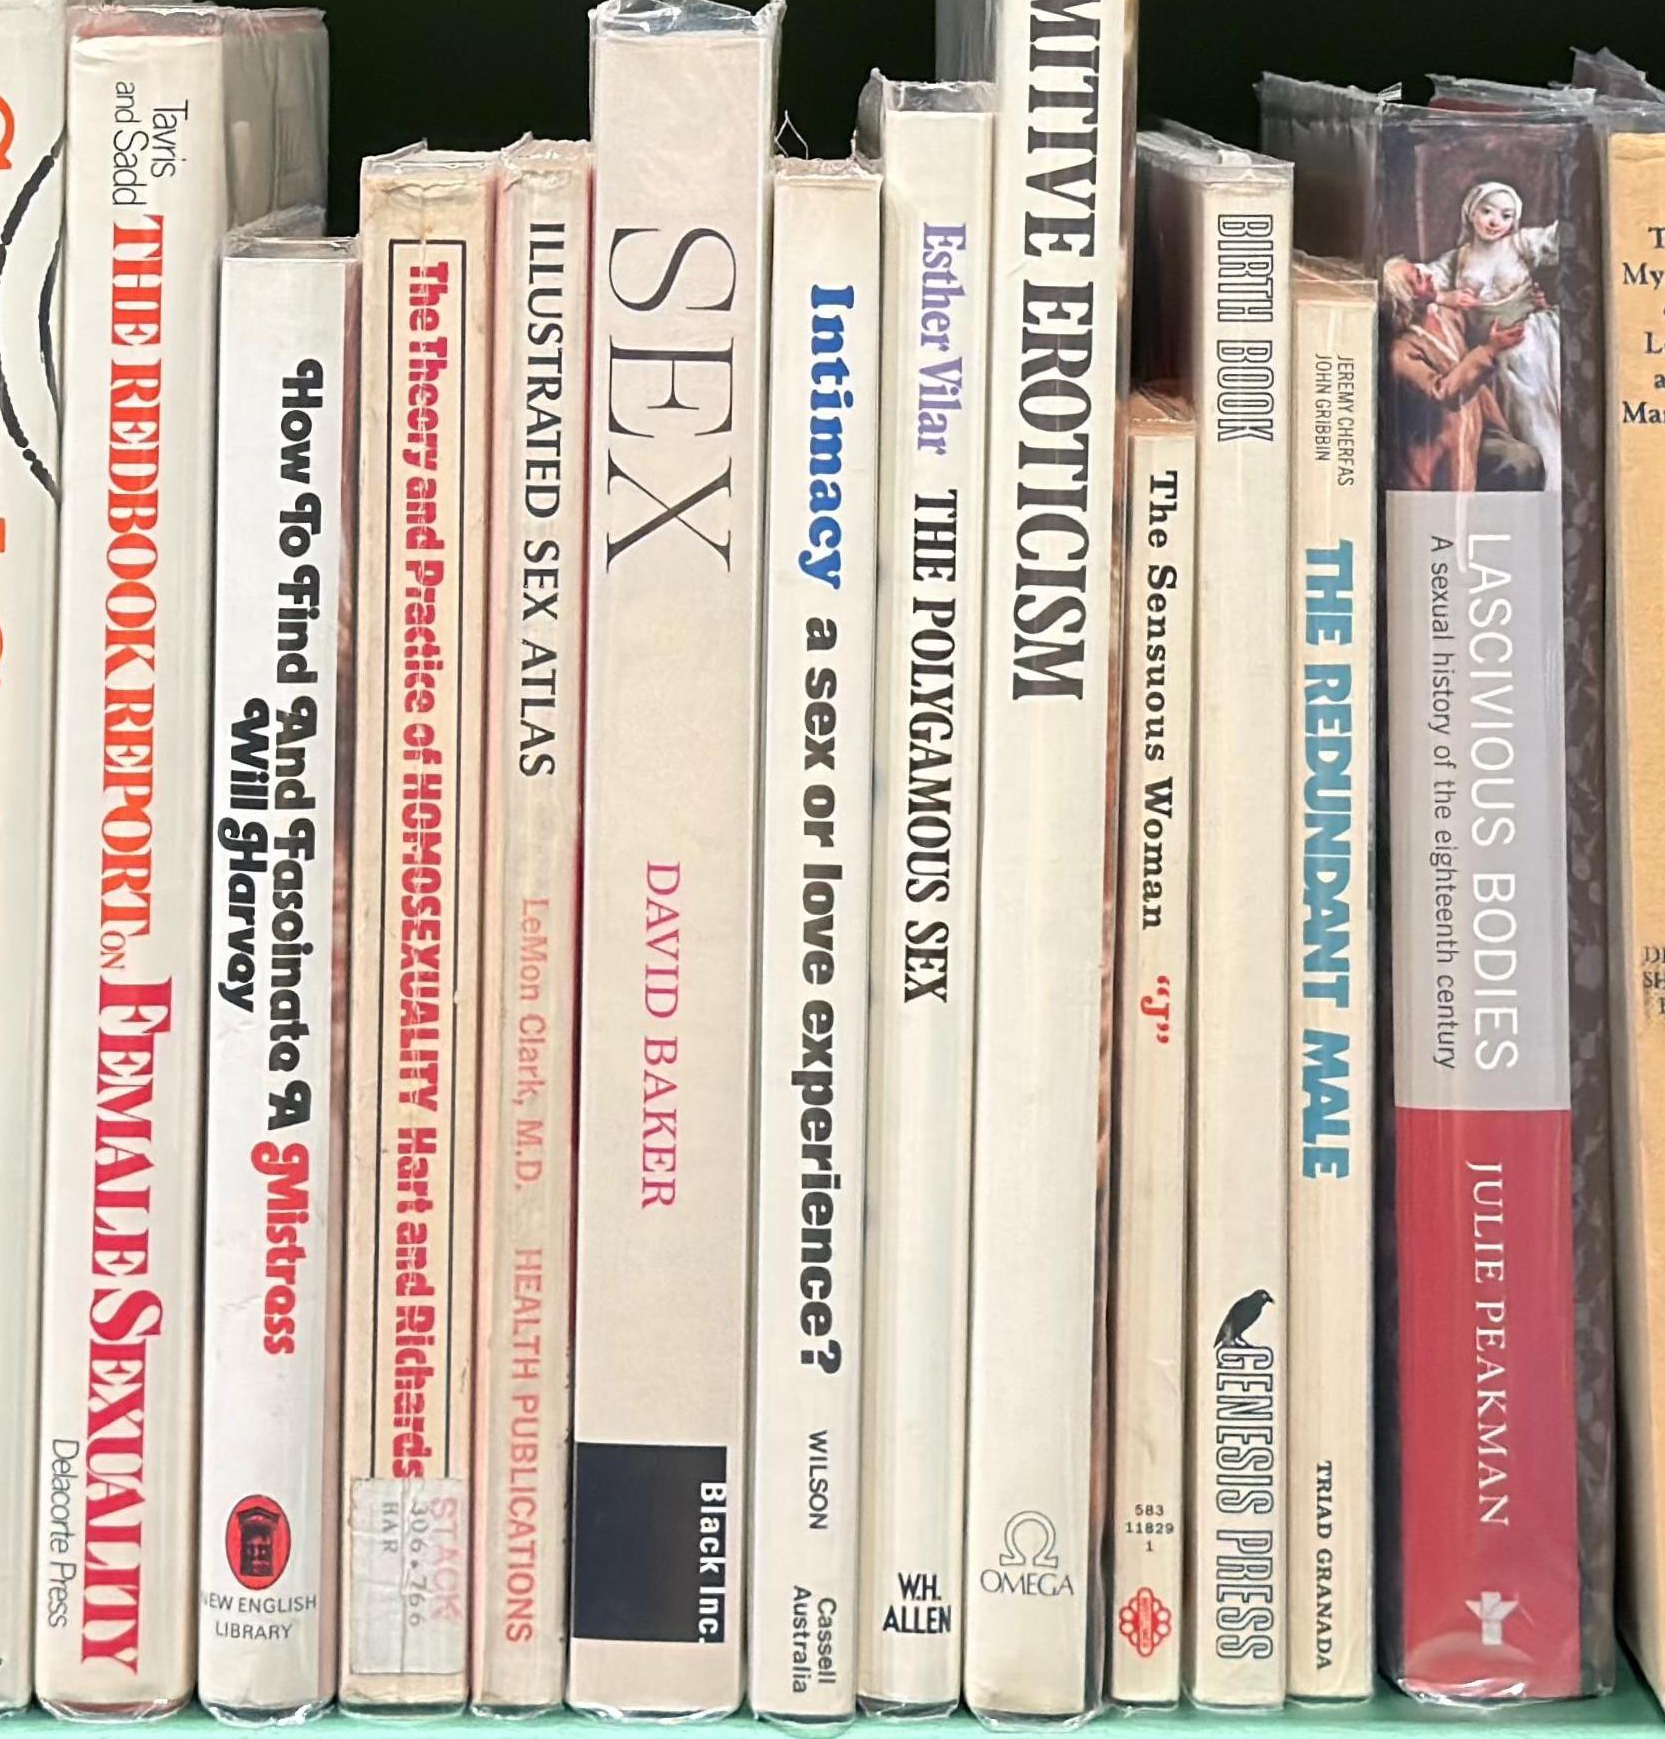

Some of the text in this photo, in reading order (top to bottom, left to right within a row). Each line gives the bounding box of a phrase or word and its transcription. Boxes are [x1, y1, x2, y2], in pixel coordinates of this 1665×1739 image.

[605, 226, 737, 574] SEX
[916, 220, 968, 457] Esther Vilar
[1314, 353, 1333, 462] JOHN GRIBBIN
[1336, 356, 1355, 486] JEREMY CHERFAS
[518, 222, 566, 777] ILLUSTRATED SEX ATLAS
[1011, 278, 1095, 702] EROTICISM
[790, 283, 855, 1376] Intimacy a sex or love experience?
[1141, 469, 1179, 931] The Sensuous Woman
[1427, 534, 1460, 1071] A sexual history of the eighteenth century
[1467, 532, 1519, 1071] LASCIVIOUS BODIES
[80, 214, 173, 1676] THE REDBOOK REPORT ON FEMALE SEXUALITY
[391, 261, 450, 1478] The Theory and Practice of HOMOSEXUALITY Hart and Richards
[641, 861, 681, 1210] DAVID BAKER
[505, 1248, 543, 1645] HEALTH PUBLICATIONS
[808, 1429, 828, 1530] WILSON
[1465, 1161, 1510, 1528] JULIE PEAKMAN
[45, 1438, 80, 1629] Delacorte Press
[215, 1621, 293, 1640] LIBRARY
[238, 1593, 317, 1613] ENGLISH
[792, 1585, 812, 1695] Australia
[979, 1570, 1075, 1597] OMEGA
[1125, 1521, 1174, 1535] 11829
[1134, 1504, 1165, 1518] 583
[1215, 1346, 1275, 1659] GENESIS PRESS
[1315, 1459, 1334, 1672] TRIAD GRANADA
[816, 1597, 838, 1686] Cassell
